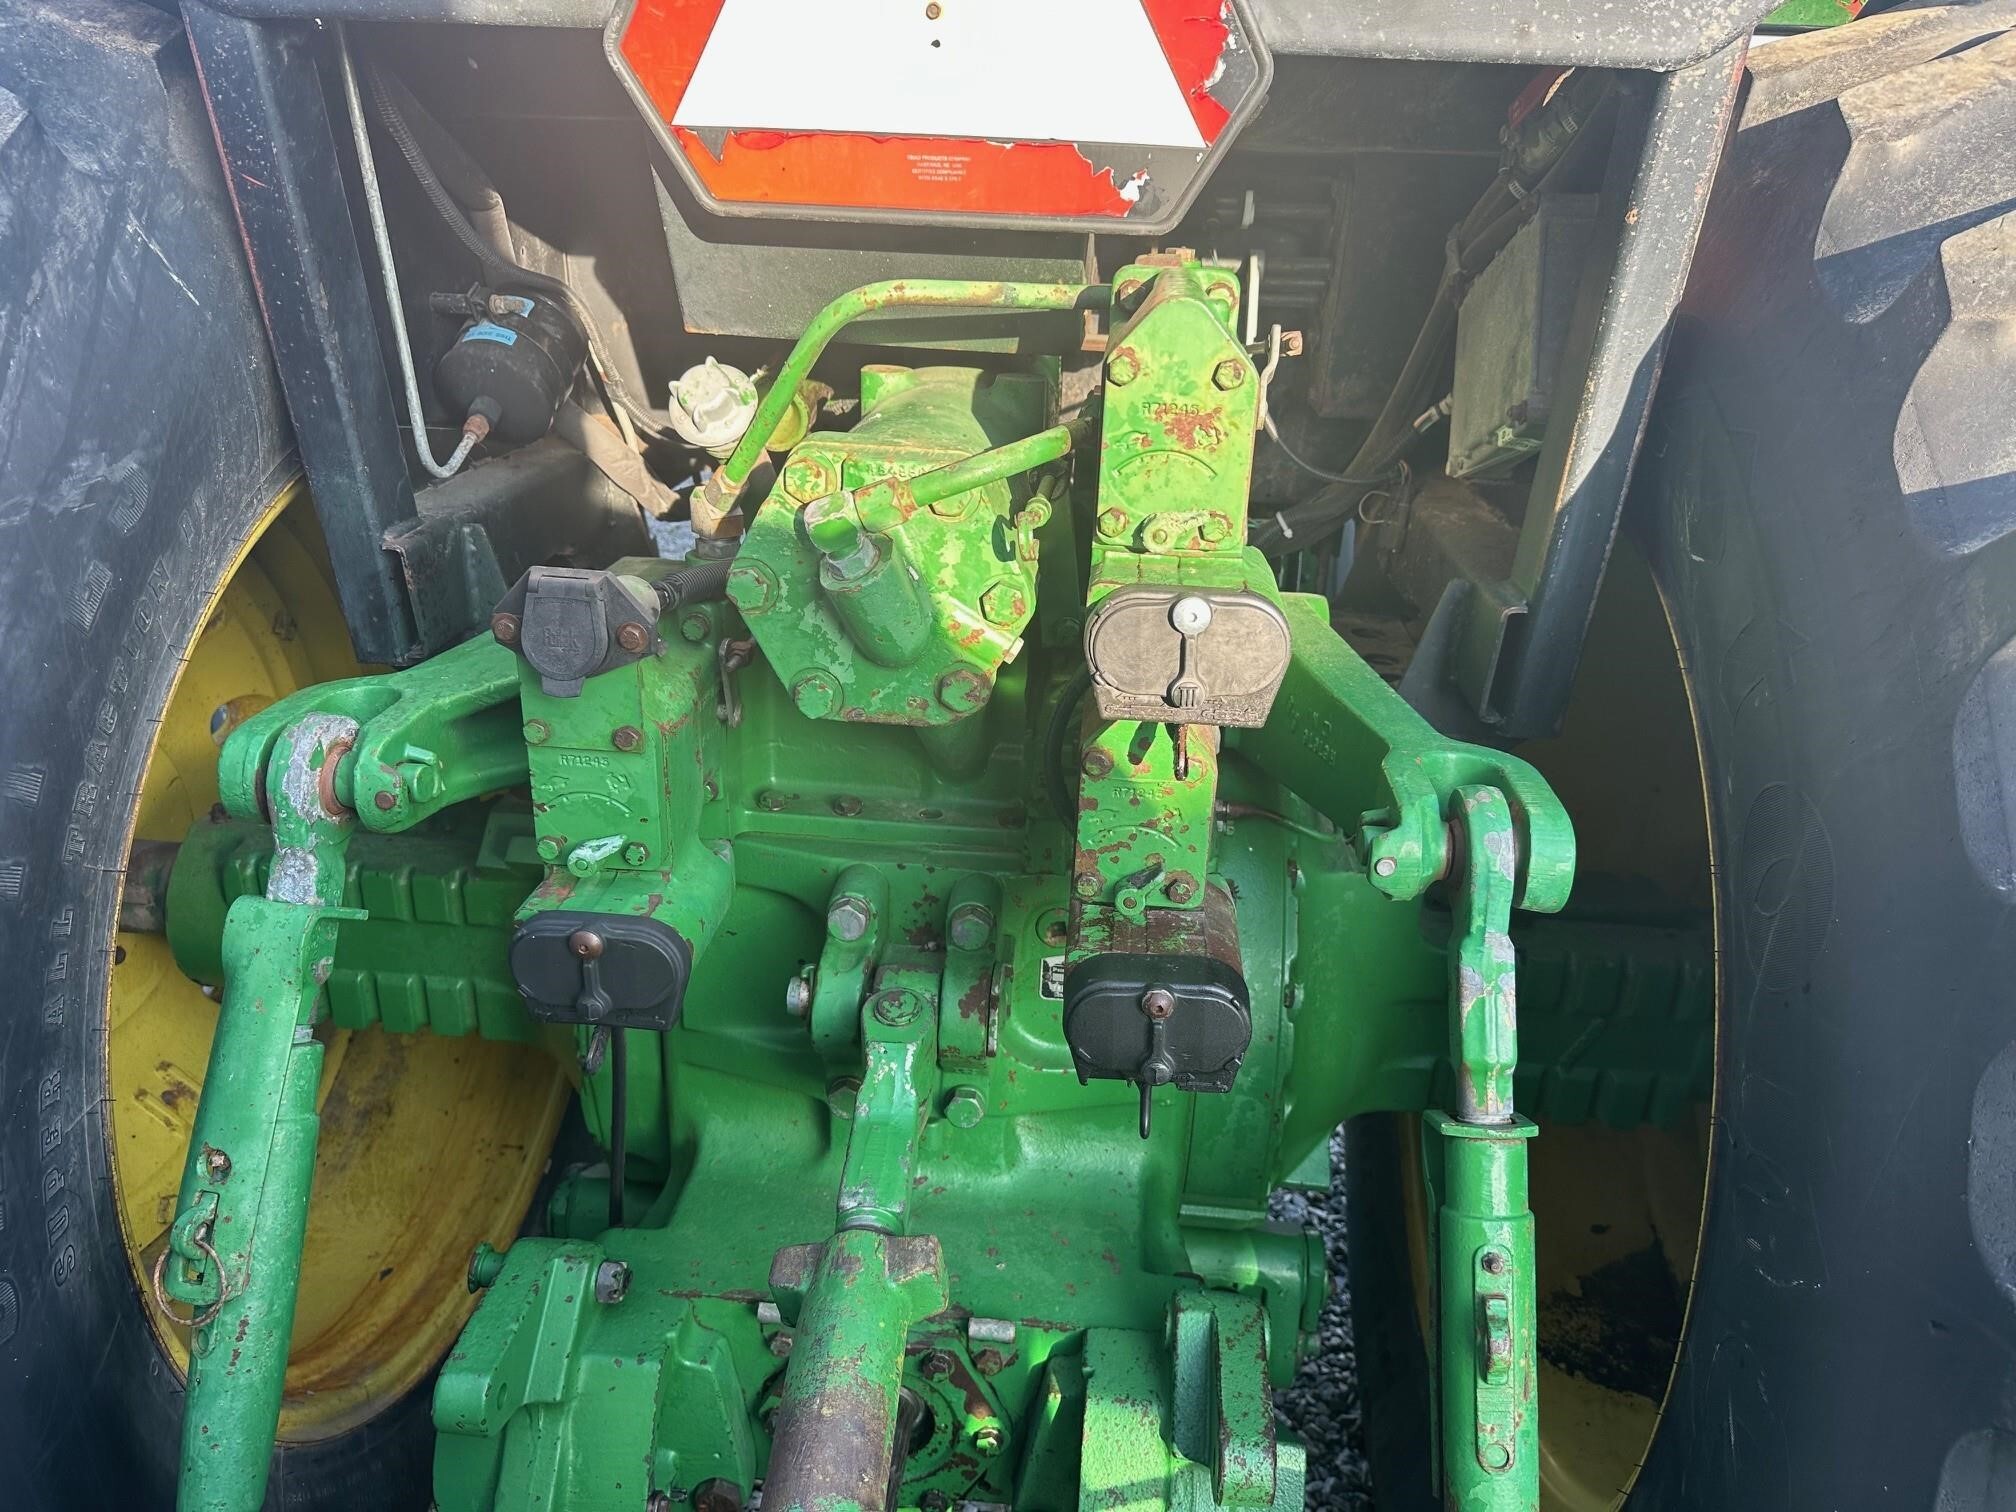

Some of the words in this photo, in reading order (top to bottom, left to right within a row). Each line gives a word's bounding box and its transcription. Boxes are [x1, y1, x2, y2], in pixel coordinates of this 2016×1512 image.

[1142, 401, 1200, 416] R71245
[63, 553, 171, 864] TRACTION
[43, 905, 74, 1028] ALL
[39, 1068, 76, 1287] SUPER
